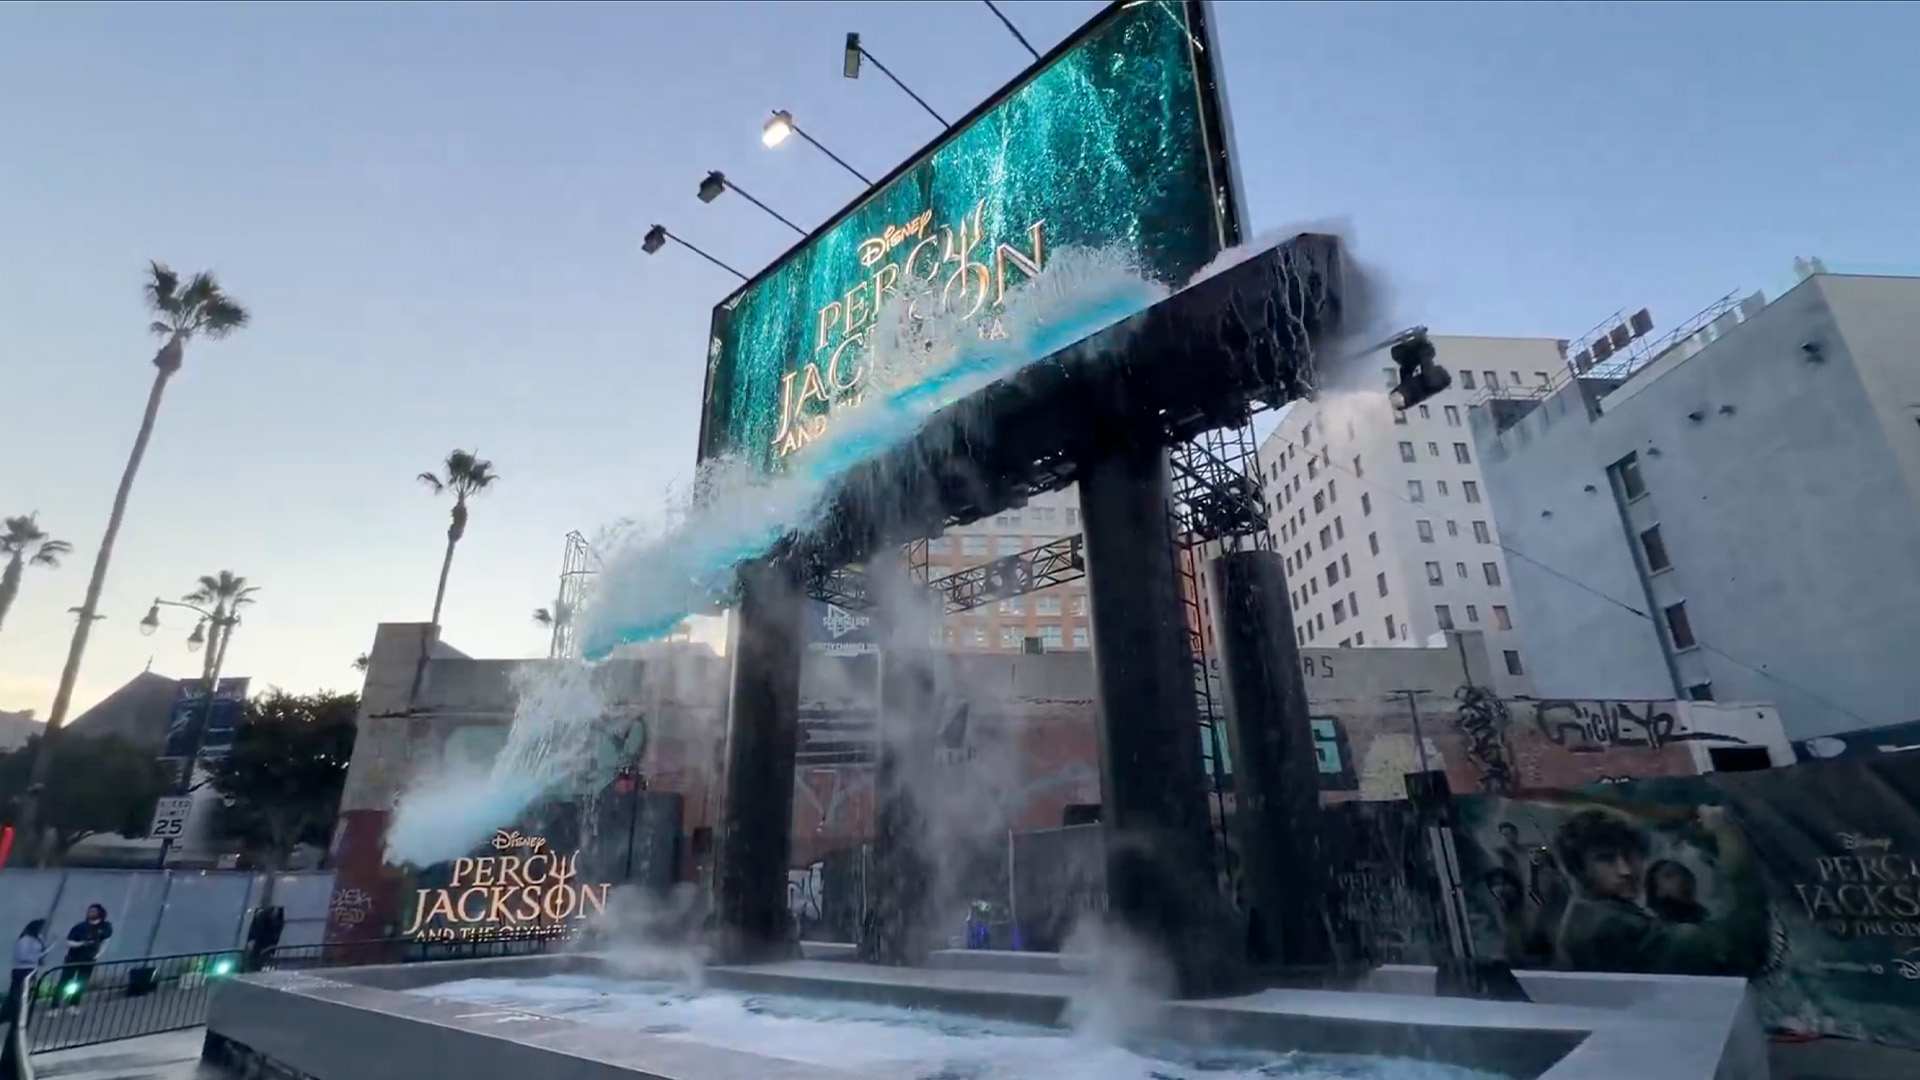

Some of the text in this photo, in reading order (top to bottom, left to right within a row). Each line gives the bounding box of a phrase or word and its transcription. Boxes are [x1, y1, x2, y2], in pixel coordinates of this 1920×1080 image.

[858, 209, 933, 267] Disney
[771, 219, 1047, 446] JACON
[160, 800, 190, 808] SEED
[153, 819, 183, 835] 25
[490, 829, 547, 854] Disney
[449, 849, 580, 888] PERCY
[402, 883, 611, 935] JACKSON
[1794, 883, 1920, 920] JACKS
[413, 927, 455, 943] AND
[460, 926, 495, 942] THE
